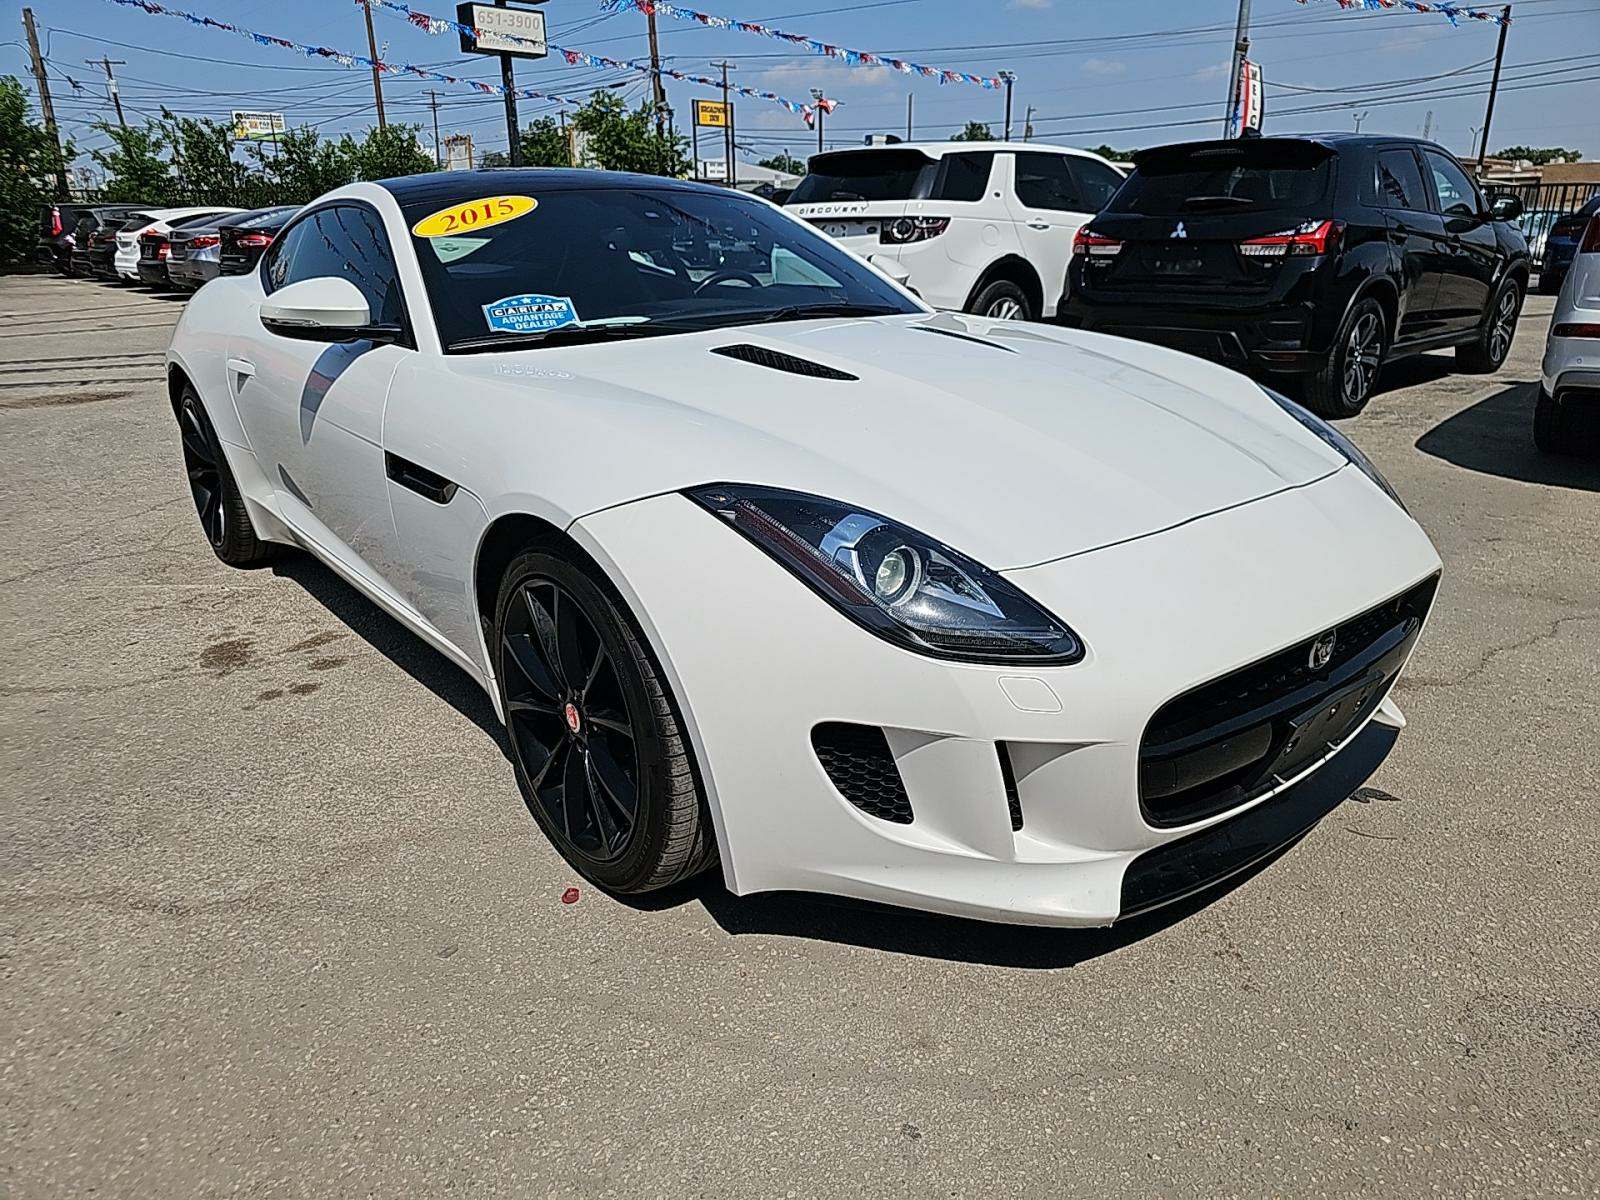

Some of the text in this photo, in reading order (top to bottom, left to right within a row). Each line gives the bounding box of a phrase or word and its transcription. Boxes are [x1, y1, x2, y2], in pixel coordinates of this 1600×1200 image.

[478, 10, 540, 31] 651-3900
[440, 199, 514, 232] 2015
[799, 205, 867, 215] DISCOVERY
[493, 303, 566, 317] CARFAX
[502, 312, 565, 325] ADVANTAGE
[514, 319, 557, 330] DEALER
